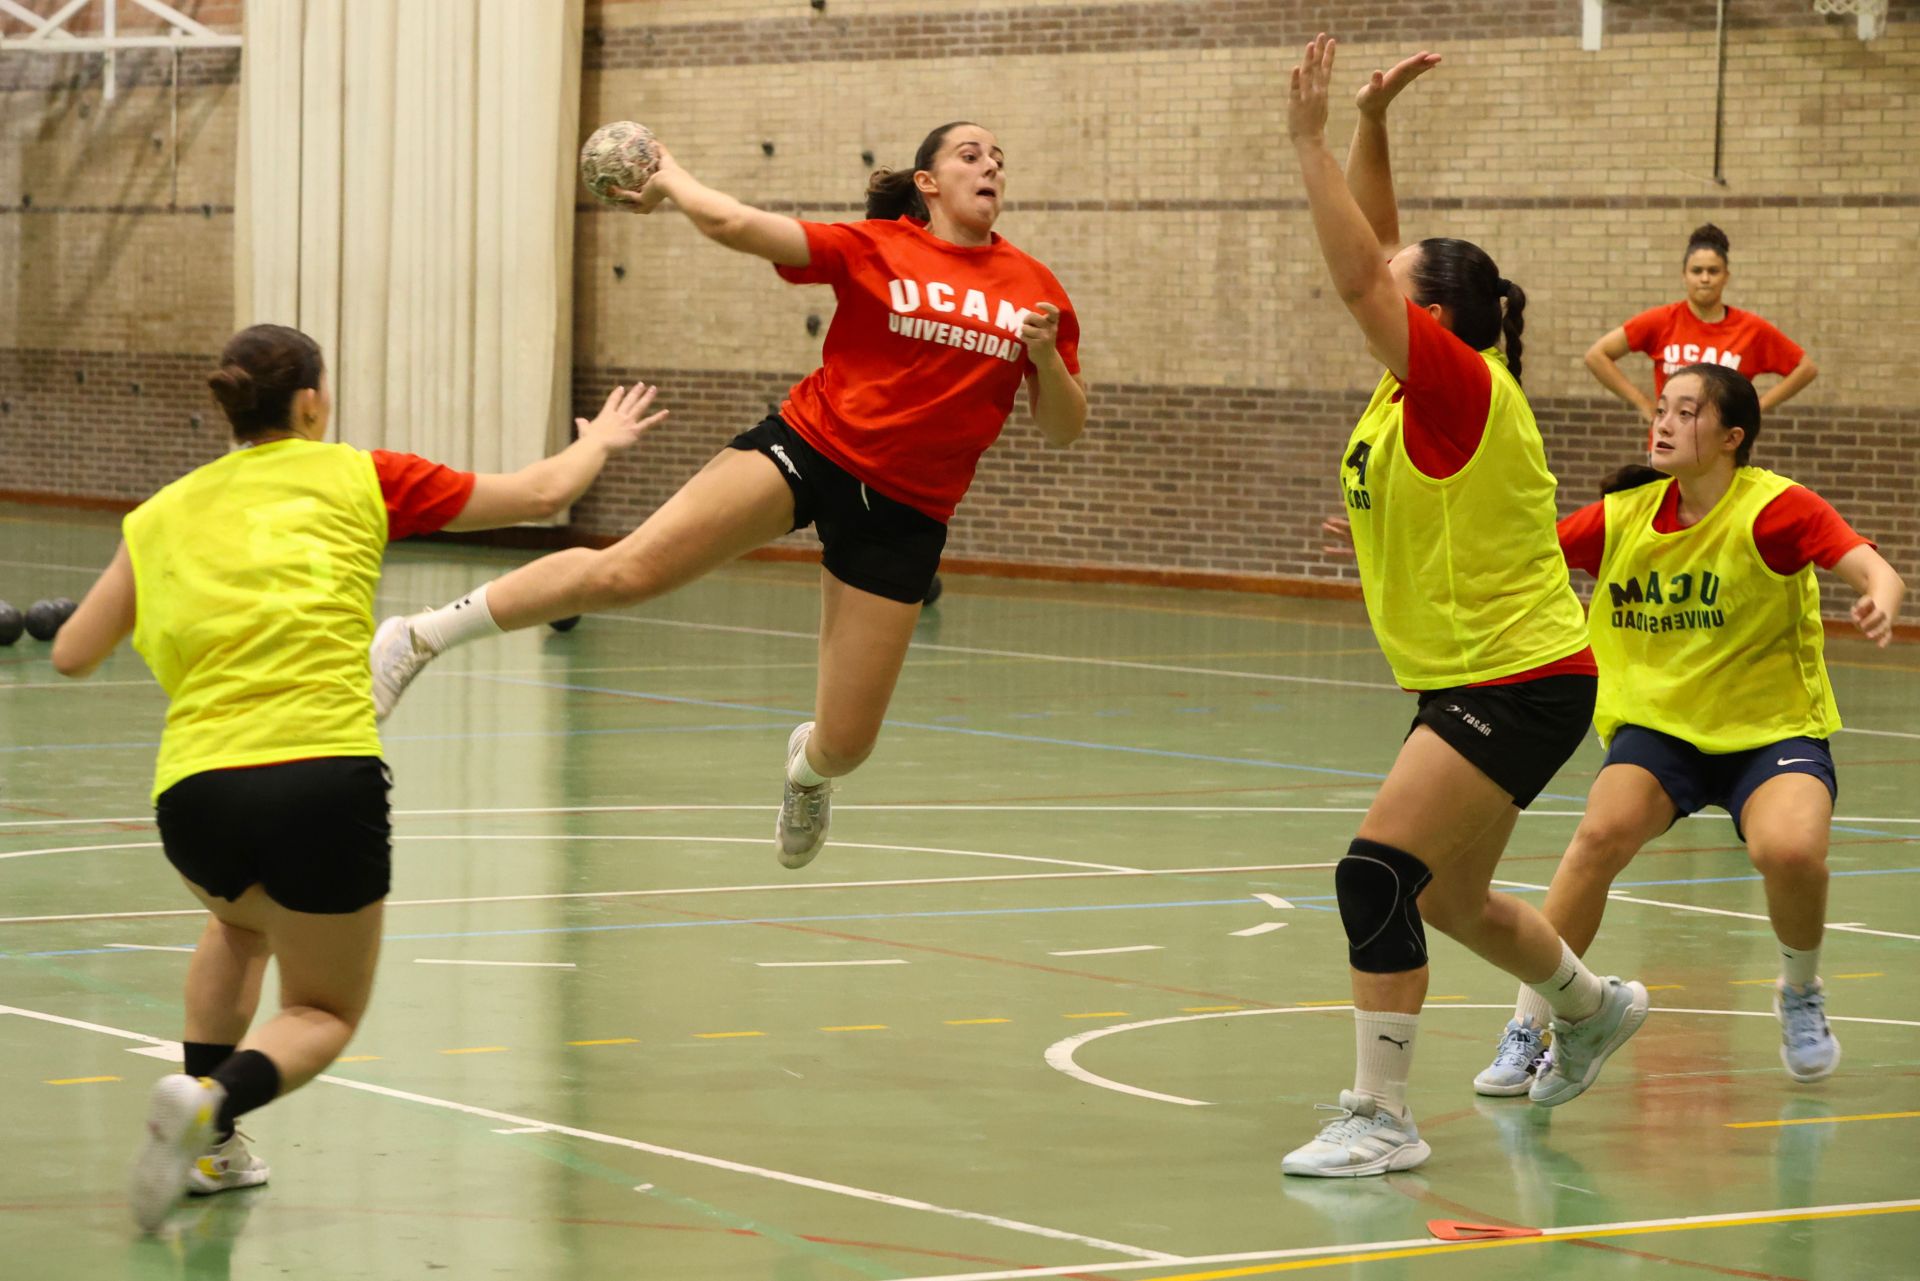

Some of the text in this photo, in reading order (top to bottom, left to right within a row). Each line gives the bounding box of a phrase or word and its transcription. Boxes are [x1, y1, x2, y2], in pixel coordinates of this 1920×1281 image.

[888, 279, 1034, 339] UCAM
[888, 312, 1022, 363] UNIVERSIDAD
[1663, 343, 1742, 371] UCAM
